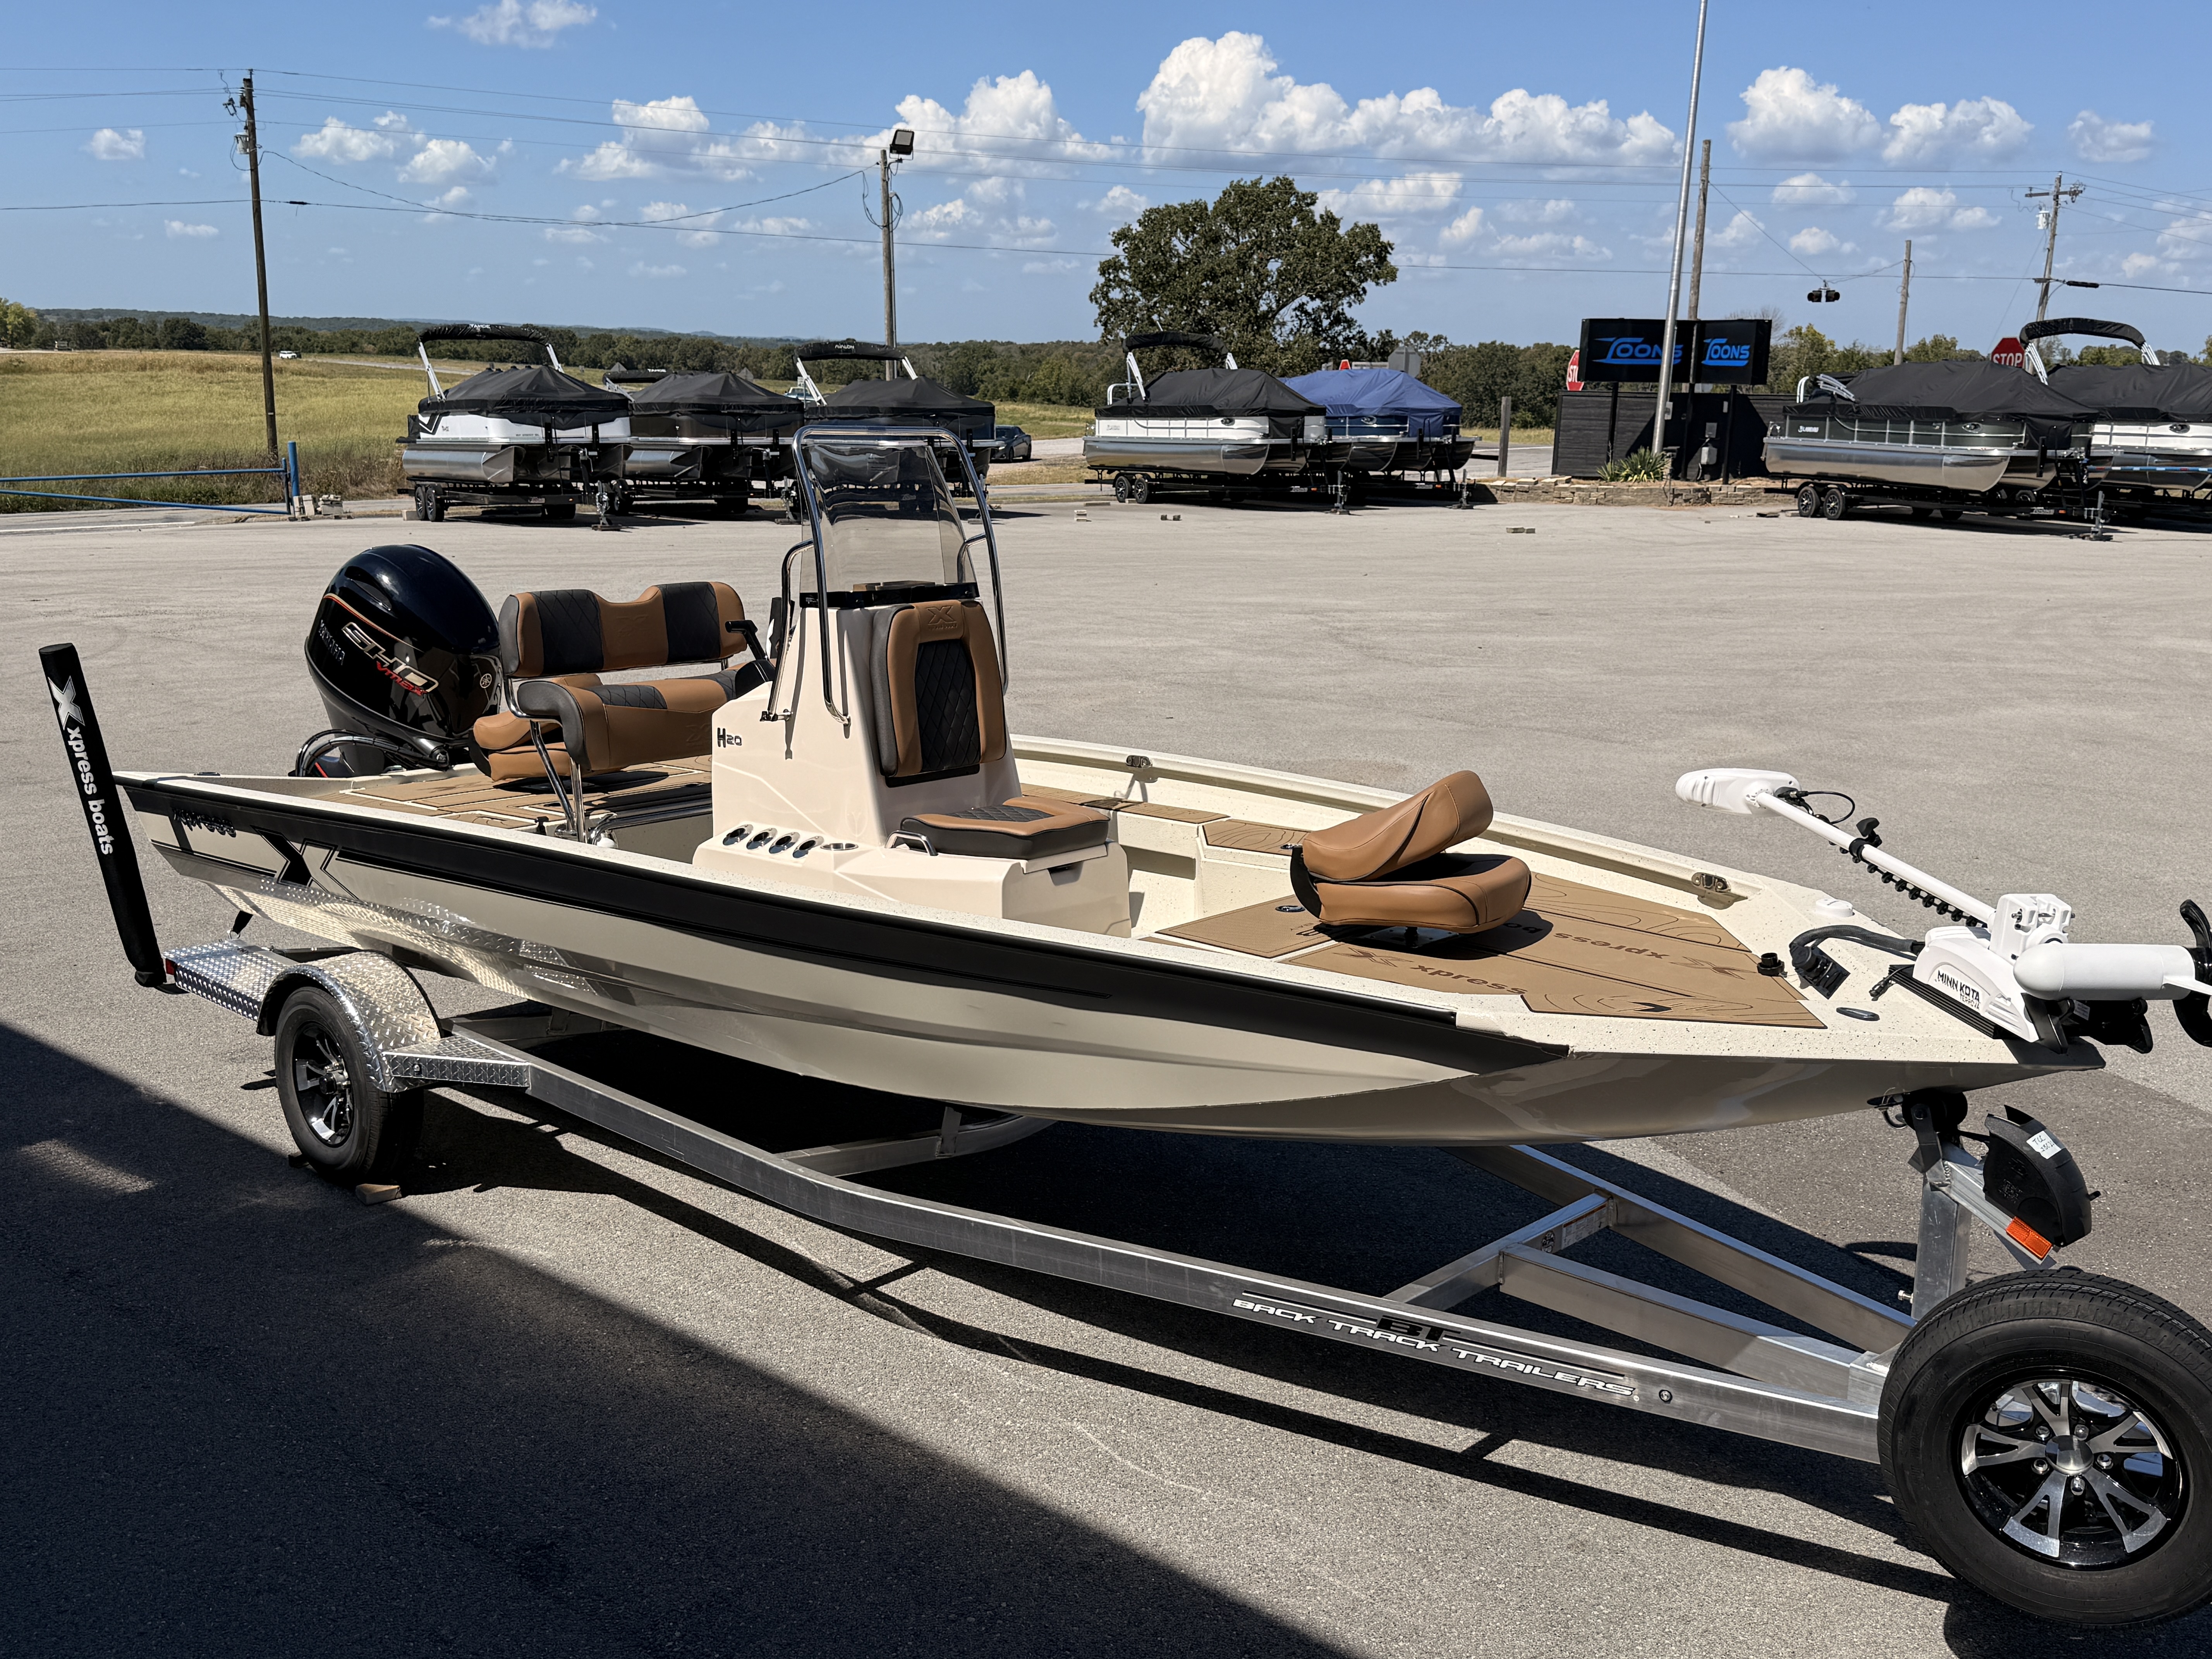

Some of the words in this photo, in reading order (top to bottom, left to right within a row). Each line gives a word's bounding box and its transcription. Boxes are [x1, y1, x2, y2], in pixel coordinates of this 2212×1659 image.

[1701, 338, 1750, 366] TOONS
[1993, 353, 2022, 367] STOP
[67, 726, 97, 795] xpress
[88, 799, 115, 855] boats
[1409, 964, 1528, 994] xpress
[1937, 970, 1958, 992] MINN
[1960, 982, 1980, 1003] KOTA
[1232, 1298, 1320, 1324] BACK
[1328, 1319, 1444, 1352] TRACK
[1451, 1347, 1636, 1396] TRAILERS
